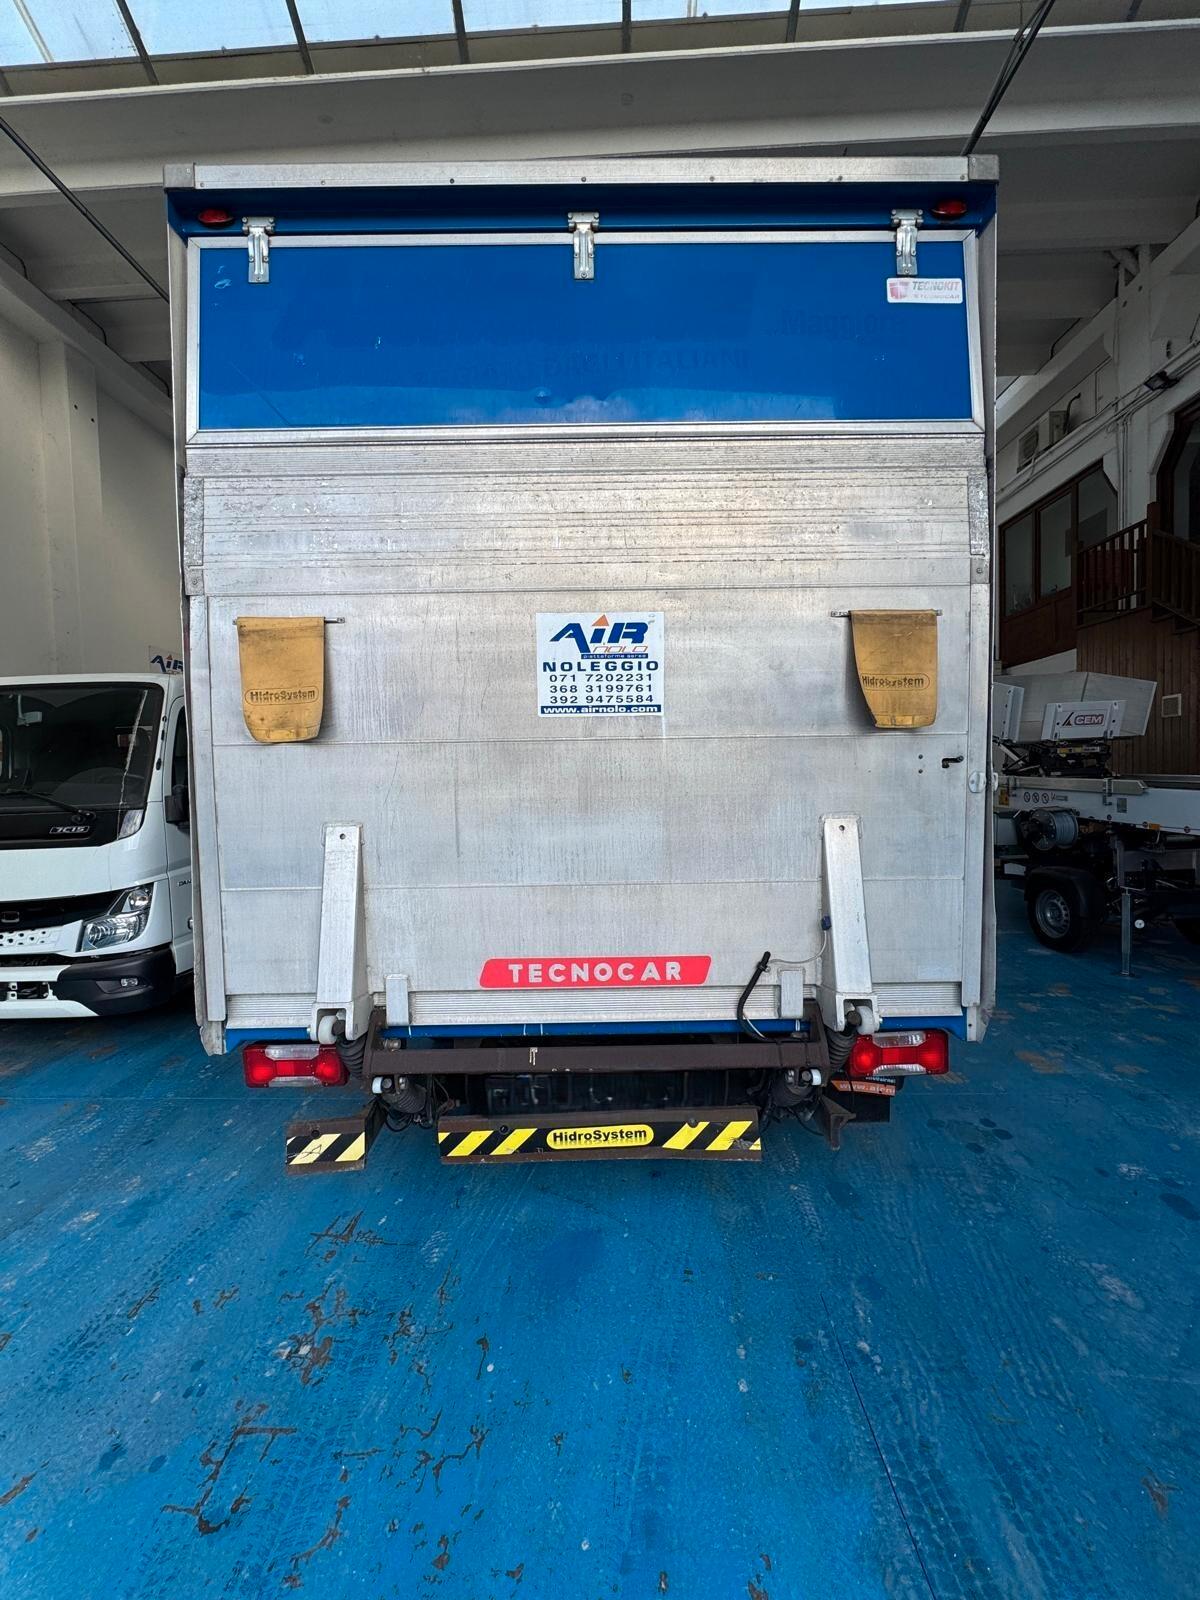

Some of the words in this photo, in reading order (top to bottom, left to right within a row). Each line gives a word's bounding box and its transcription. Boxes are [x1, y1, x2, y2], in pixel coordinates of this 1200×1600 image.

[912, 280, 960, 291] TECNOKIT
[542, 661, 659, 672] NOLEGGIO
[549, 674, 576, 683] 071
[585, 673, 652, 682] 7202231
[549, 685, 578, 693] 368
[585, 684, 652, 693] 3199761
[250, 689, 316, 702] HidroSystem
[550, 695, 578, 704] 392
[585, 694, 654, 704] 9475584
[543, 705, 658, 714] www.airnolo.com
[1074, 714, 1104, 726] CEM
[508, 961, 681, 983] TECNOCAR
[552, 1129, 647, 1142] HidroSystem
